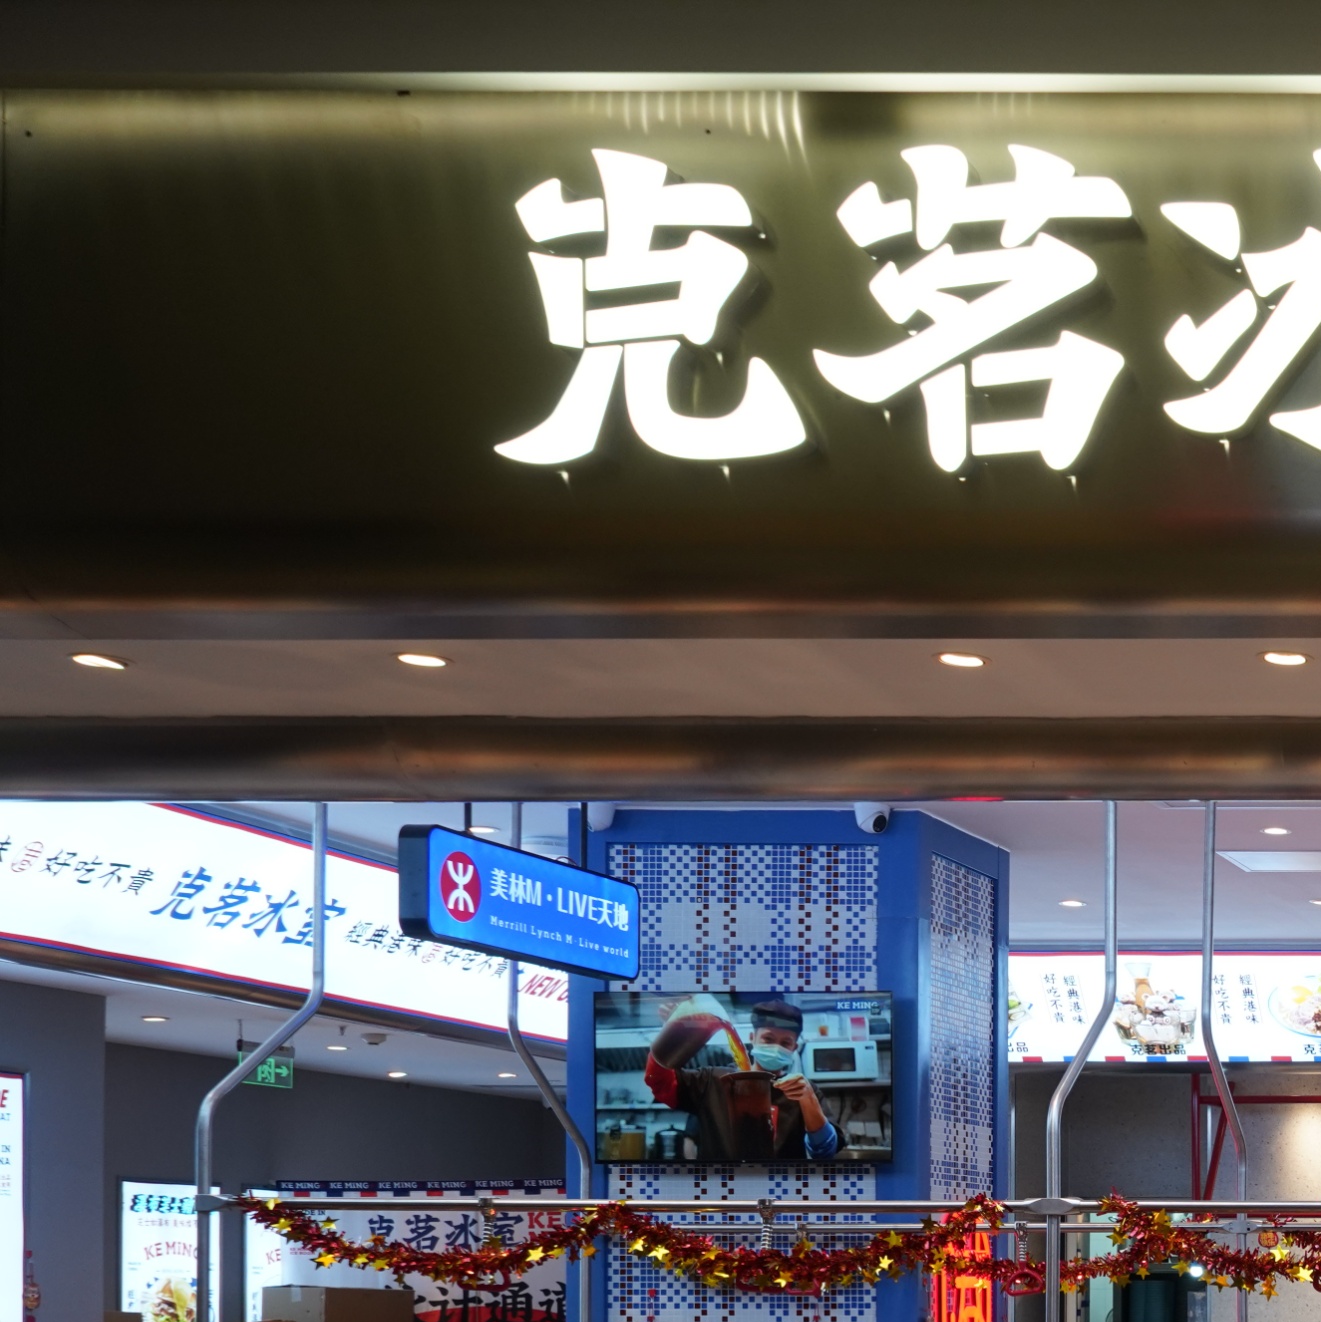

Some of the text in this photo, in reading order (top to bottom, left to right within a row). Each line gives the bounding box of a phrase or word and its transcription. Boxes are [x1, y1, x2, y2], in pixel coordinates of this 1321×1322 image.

[39, 849, 154, 896] 好吃不貴
[150, 865, 346, 948] 克茗冰室
[490, 915, 527, 933] Merrill
[531, 925, 562, 942] Lynch
[603, 946, 629, 958] world
[1043, 973, 1065, 1023] 好吃不貴
[1063, 975, 1086, 1025] 經典港味
[1212, 973, 1232, 1025] 好吃不貴
[1239, 974, 1259, 1025] 經典港味
